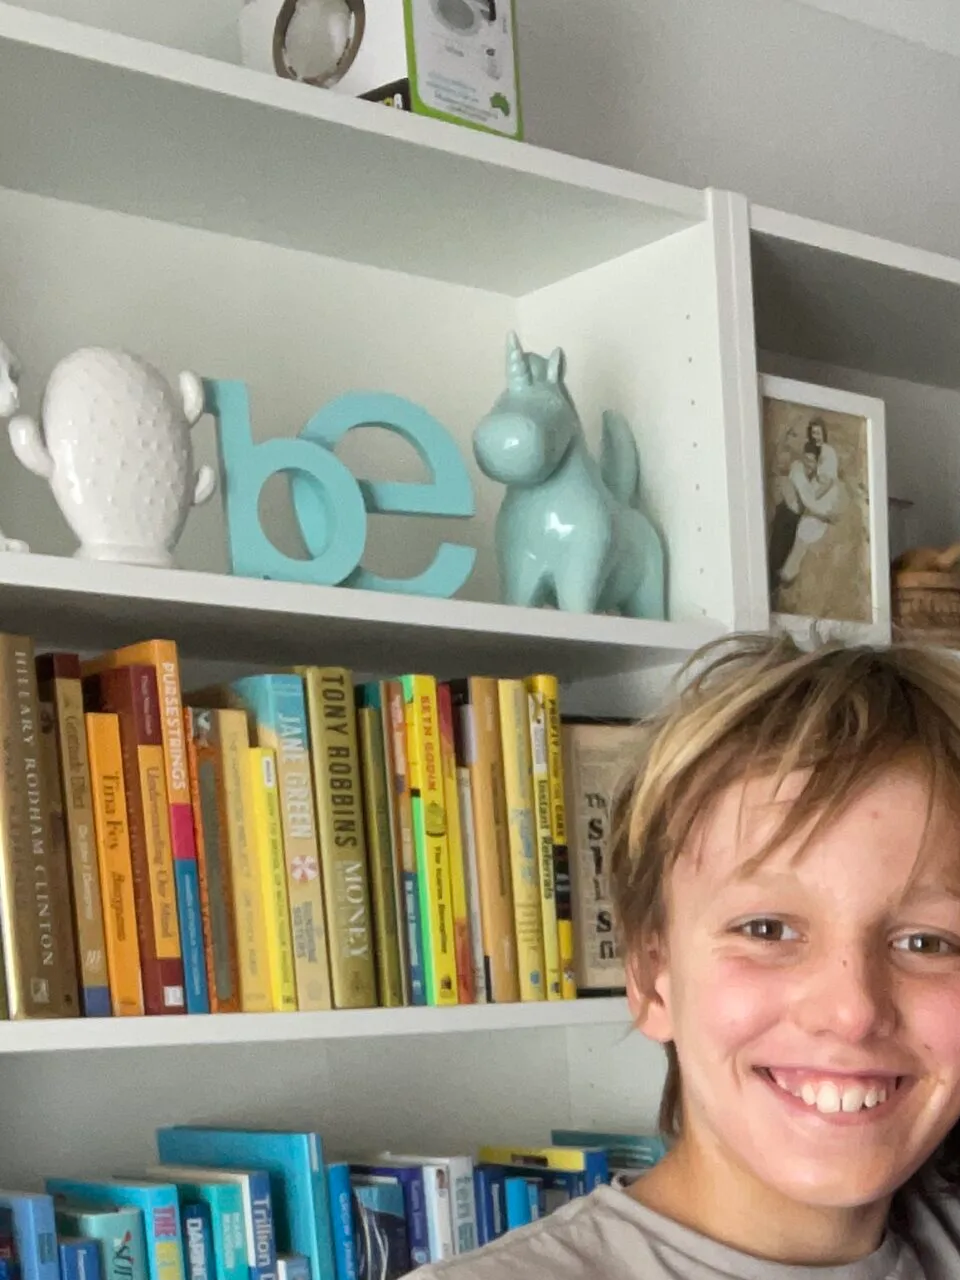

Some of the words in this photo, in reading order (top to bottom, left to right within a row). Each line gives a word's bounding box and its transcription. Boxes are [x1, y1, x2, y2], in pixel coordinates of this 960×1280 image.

[203, 377, 477, 598] be
[15, 651, 35, 746] HILLARY
[162, 662, 186, 790] PURSESTRINGS
[277, 712, 305, 764] JANE
[321, 675, 349, 735] TONY
[23, 758, 45, 855] RODHAM
[102, 772, 120, 814] Tina
[284, 772, 313, 838] GREEN
[327, 746, 358, 847] ROBBINS
[35, 865, 54, 966] CLINTON
[342, 861, 369, 960] MONEY
[153, 1206, 177, 1237] THE
[254, 1195, 273, 1267] Trillion
